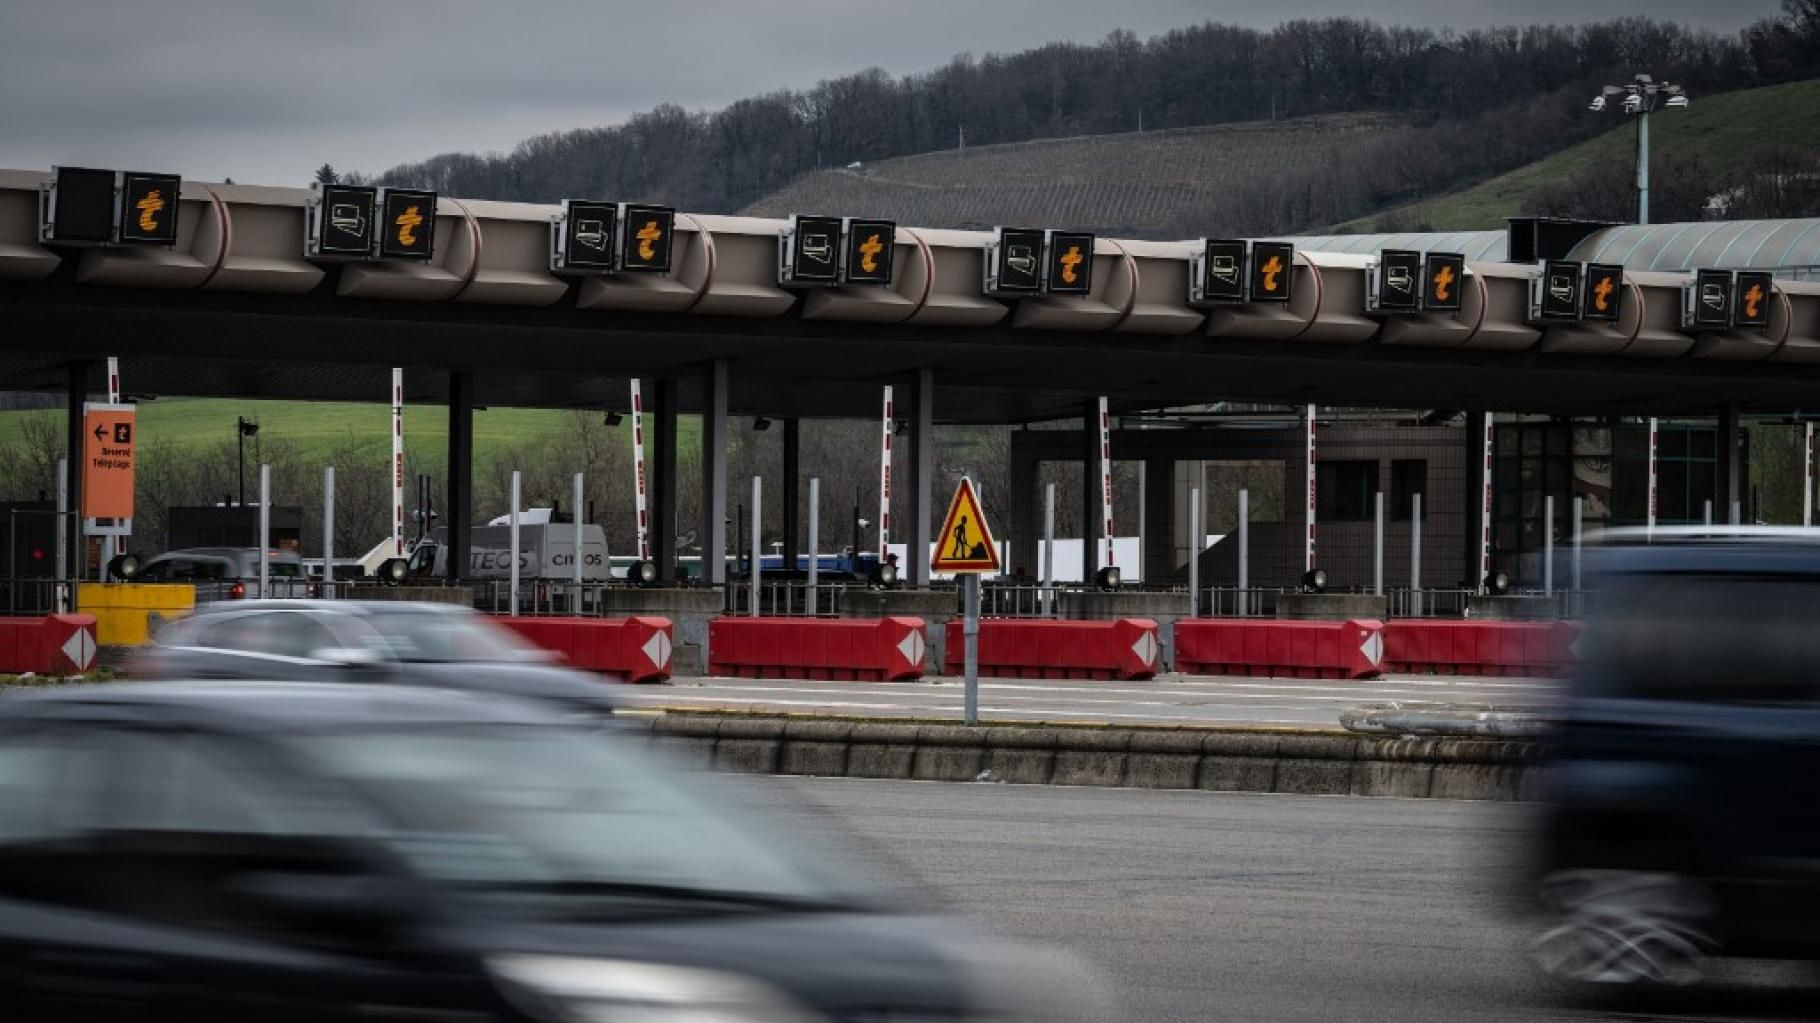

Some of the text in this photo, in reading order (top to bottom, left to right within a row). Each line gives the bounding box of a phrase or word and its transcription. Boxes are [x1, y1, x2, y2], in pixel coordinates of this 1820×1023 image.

[137, 191, 164, 231] t
[395, 206, 422, 246] t
[637, 223, 660, 260] t
[859, 235, 882, 273] t
[1062, 246, 1082, 283] t
[1261, 256, 1281, 291] t
[1434, 266, 1453, 300] t
[1595, 277, 1612, 310] t
[1746, 286, 1761, 317] t
[552, 553, 602, 566] CITOS
